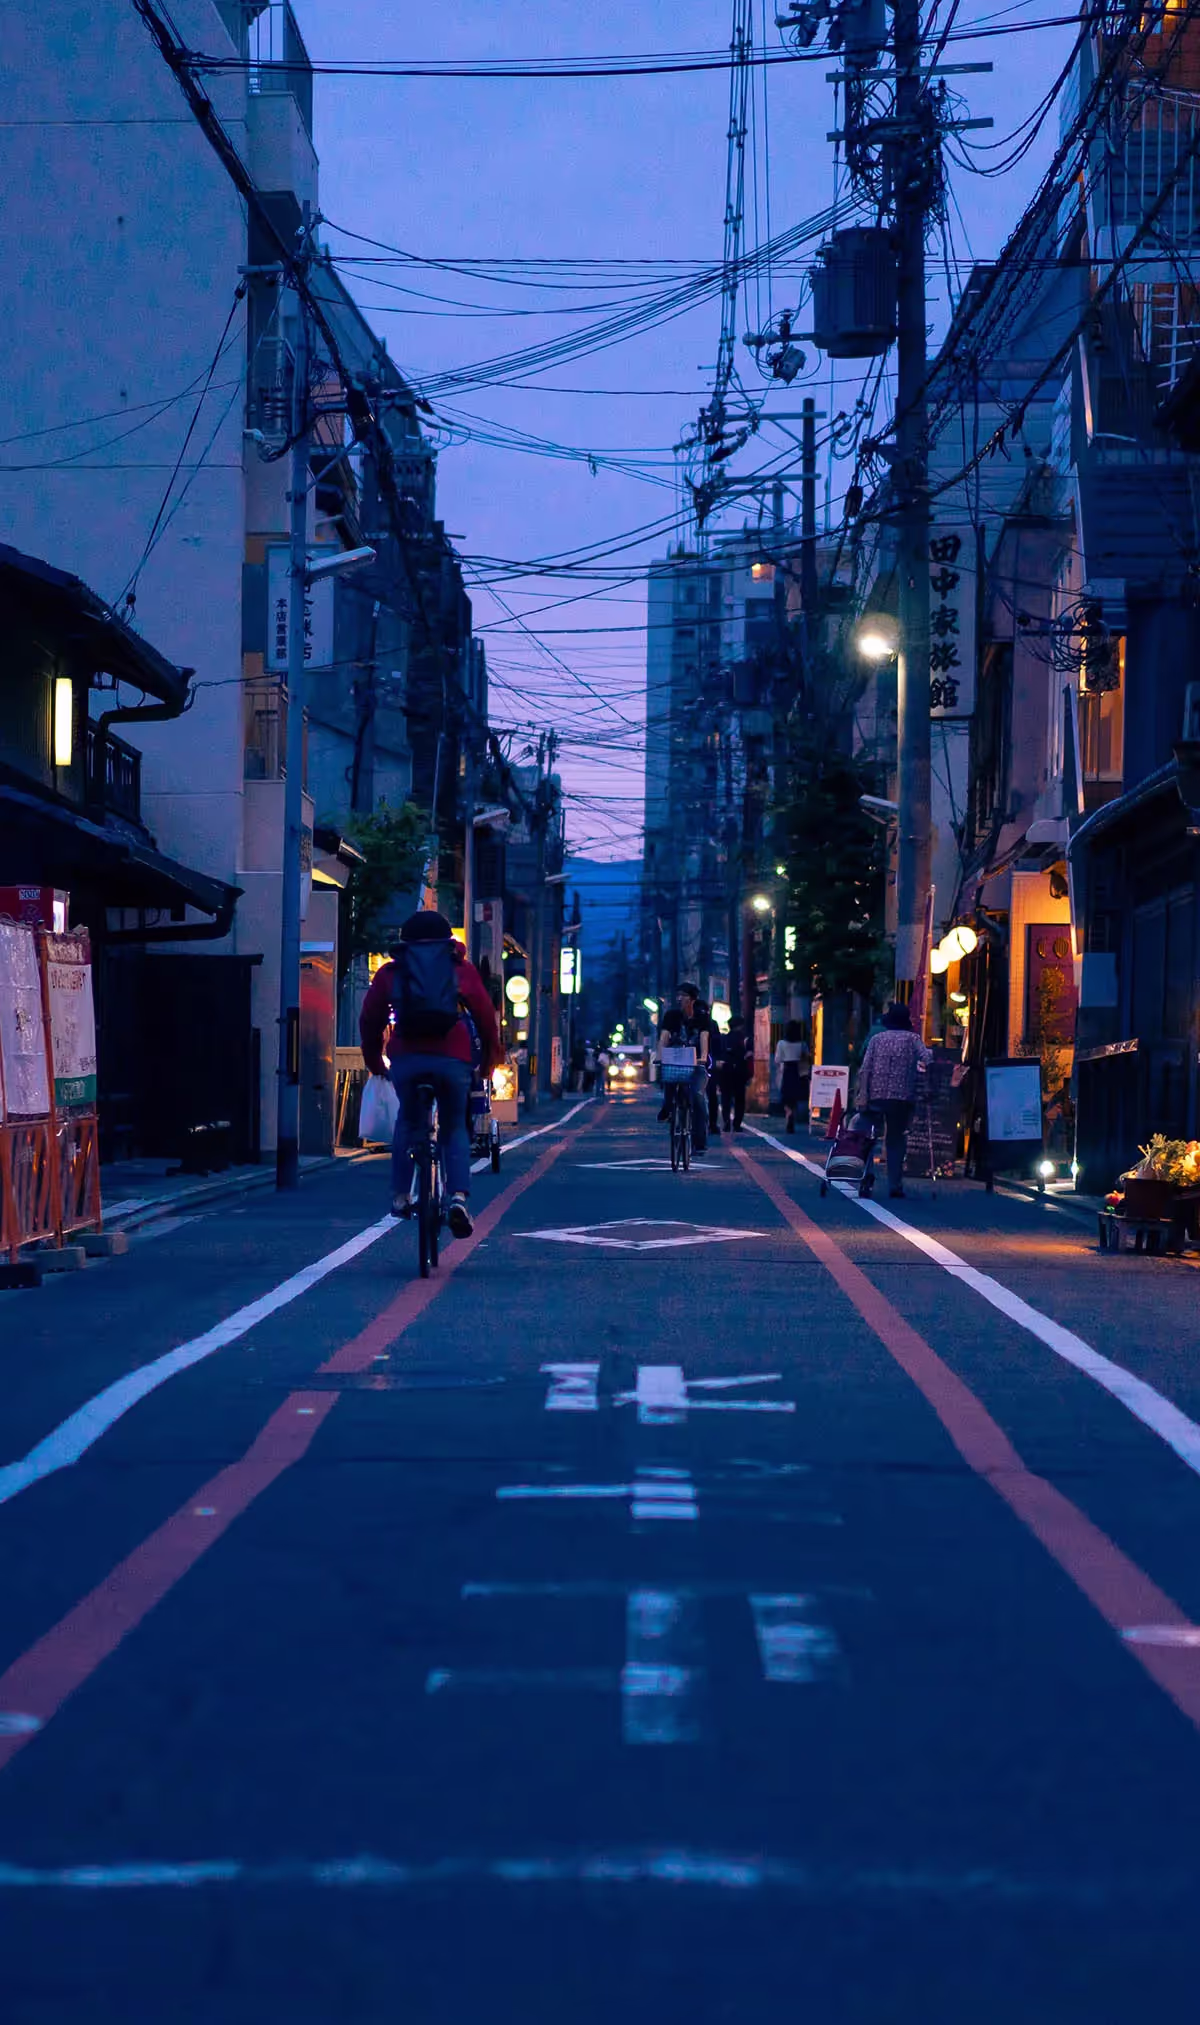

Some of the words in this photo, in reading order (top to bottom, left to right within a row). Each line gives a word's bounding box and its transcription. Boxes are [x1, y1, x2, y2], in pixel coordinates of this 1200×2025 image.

[929, 534, 962, 710] 田中家旅館
